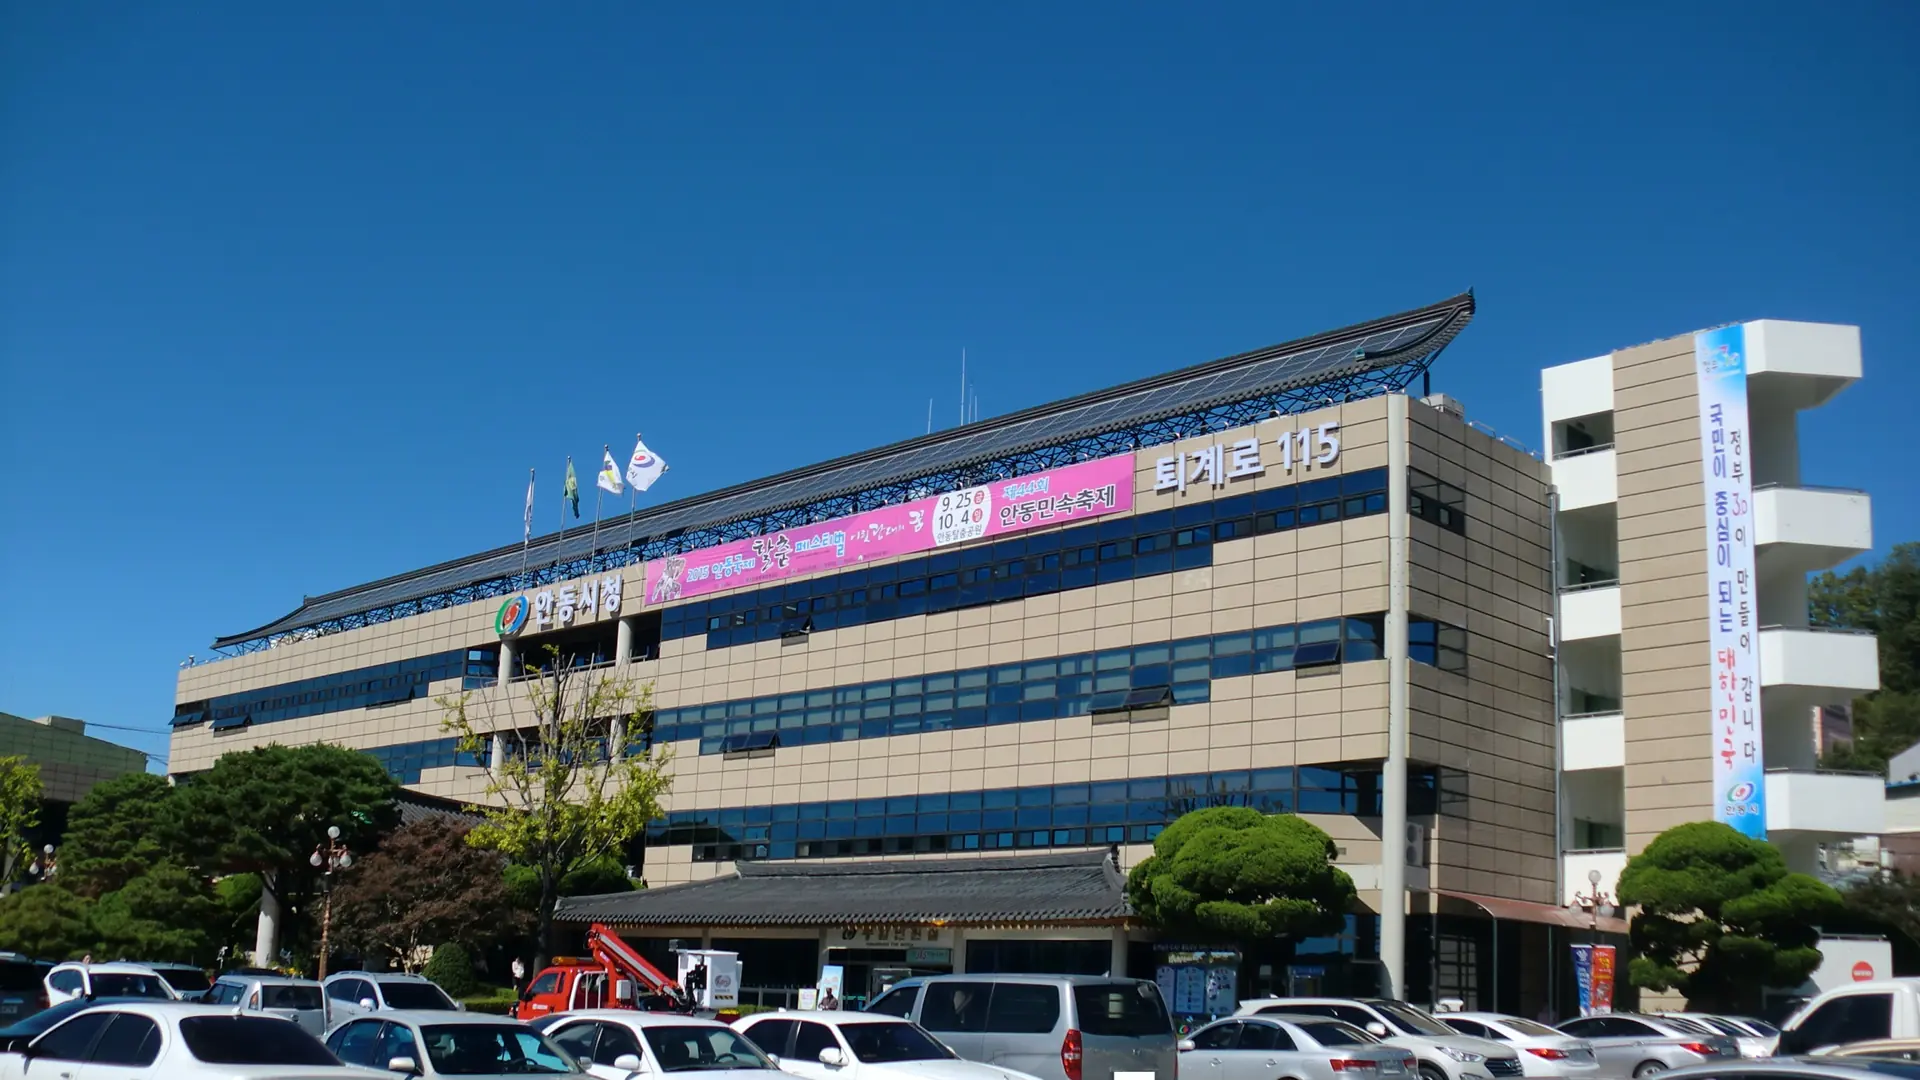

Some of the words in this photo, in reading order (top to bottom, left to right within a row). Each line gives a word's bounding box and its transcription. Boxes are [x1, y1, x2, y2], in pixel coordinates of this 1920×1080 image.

[1153, 437, 1265, 492] 퇴계로
[1277, 421, 1340, 470] 115
[1710, 403, 1726, 478] 국민이
[1000, 484, 1116, 526] 안동민속축제
[1003, 477, 1049, 500] 제44회
[937, 525, 982, 543] 안동탈춤공원
[1715, 491, 1730, 567] 중심이
[686, 565, 709, 583] 2015
[712, 554, 755, 579] 안동국제
[752, 534, 793, 572] 탈춤
[795, 530, 846, 558] 페스티벌
[534, 574, 623, 624] 안동시청
[1719, 580, 1732, 632] 되는
[1737, 568, 1751, 654] 만들어
[1716, 646, 1737, 769] 대한민국
[1741, 676, 1755, 763] 갑니다
[1725, 804, 1759, 816] 안동시
